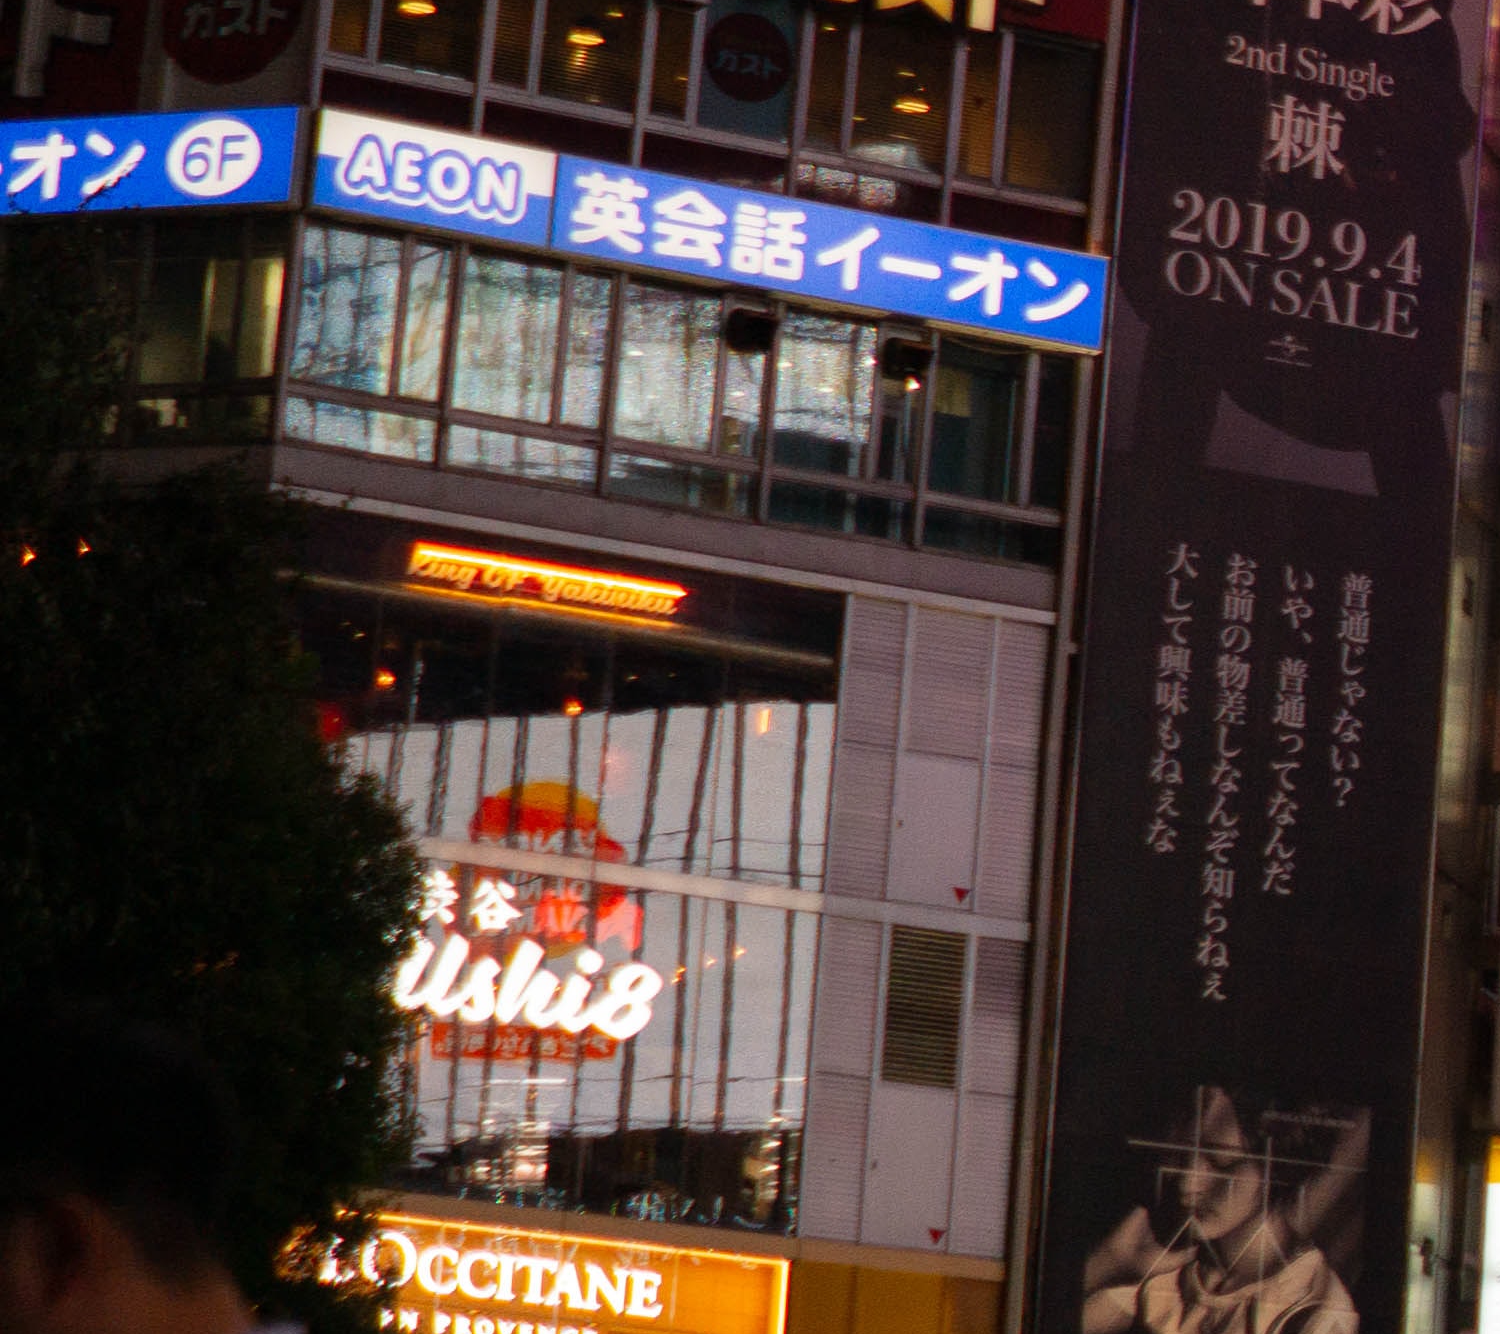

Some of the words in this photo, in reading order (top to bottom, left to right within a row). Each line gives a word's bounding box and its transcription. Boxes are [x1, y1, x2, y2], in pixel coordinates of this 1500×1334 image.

[1223, 35, 1287, 75] 2nd
[1295, 47, 1395, 102] Single
[182, 134, 252, 183] 6F
[344, 135, 524, 223] AEON
[568, 172, 1090, 324] 英会話イーオン
[1168, 189, 1423, 287] 2019.9.4
[1165, 249, 1257, 309] ON
[1270, 269, 1422, 340] SALE
[1146, 542, 1200, 854] 大して興味もねぇな
[390, 933, 664, 1041] Ushi8
[318, 1230, 664, 1319] LOCCITANE
